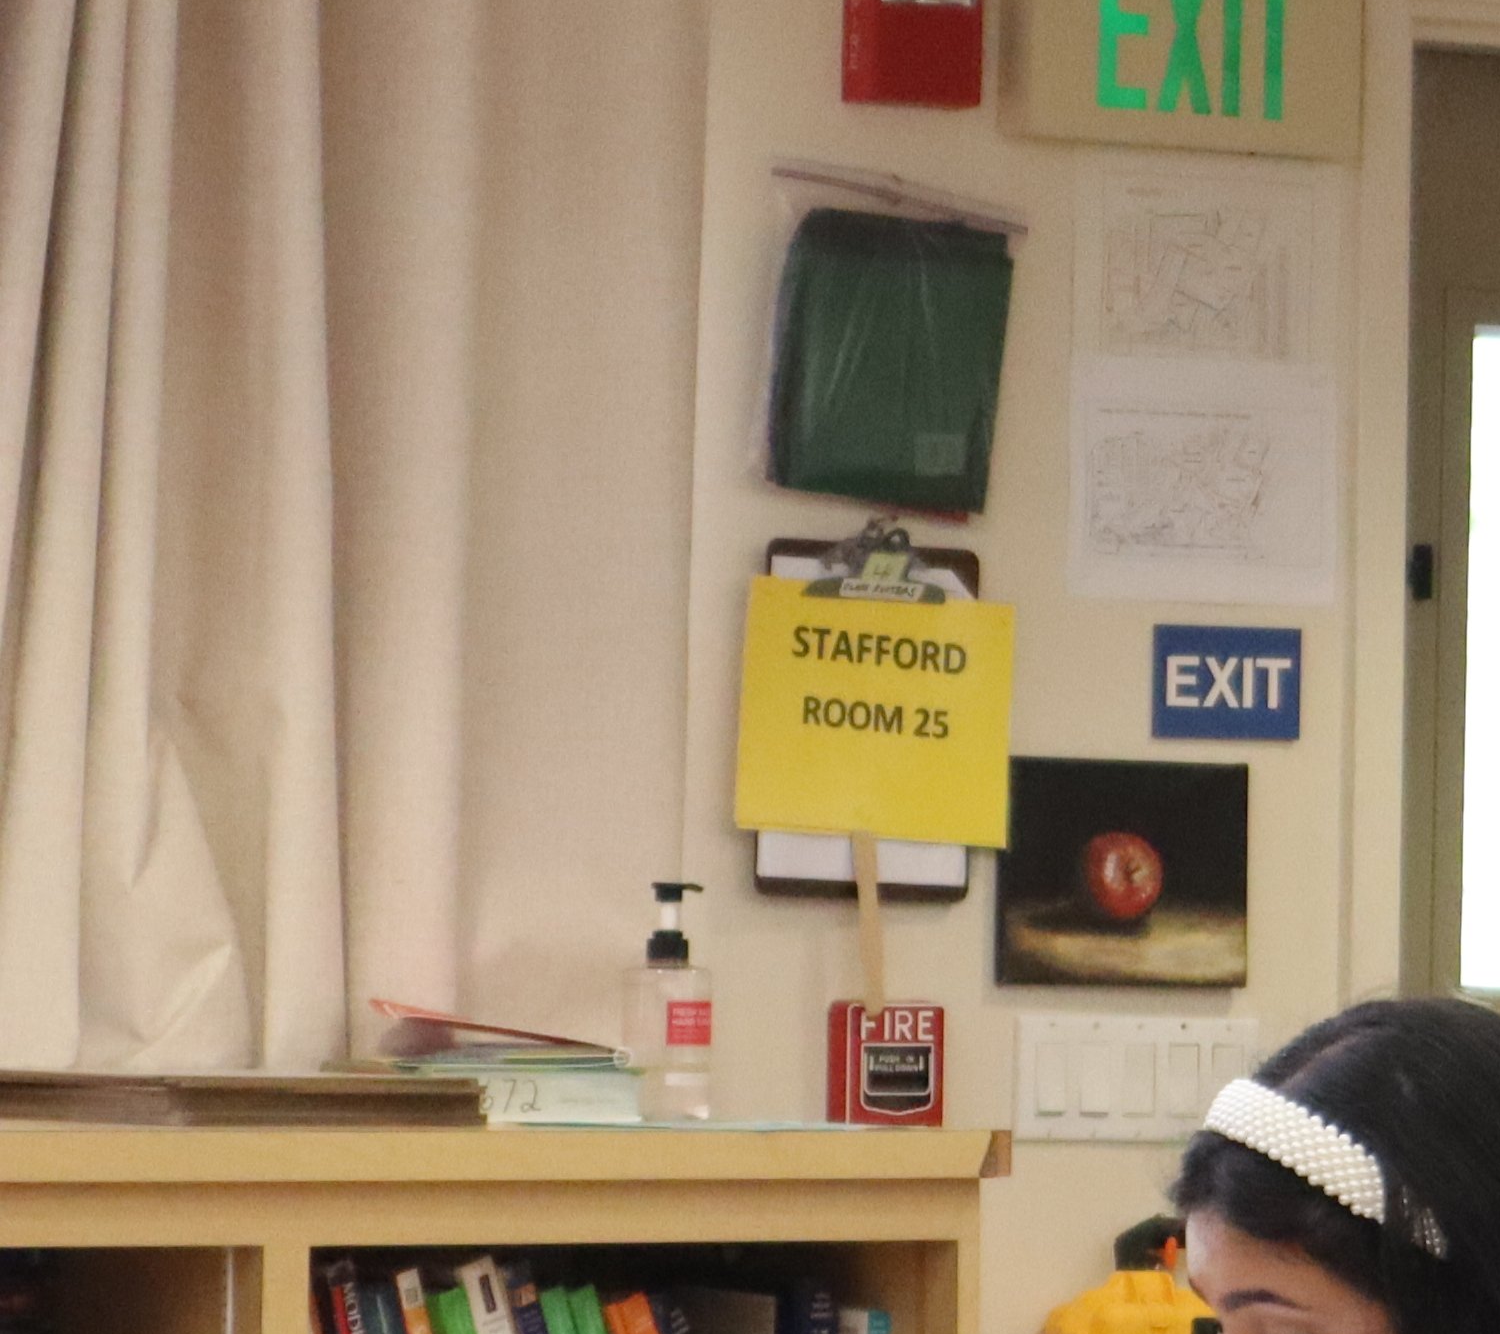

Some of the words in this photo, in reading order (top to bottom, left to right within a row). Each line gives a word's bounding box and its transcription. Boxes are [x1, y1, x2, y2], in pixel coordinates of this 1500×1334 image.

[791, 625, 967, 675] STAFFORD
[1165, 655, 1291, 710] EXIT
[803, 695, 904, 735] ROOM
[913, 708, 949, 739] 25
[860, 1010, 934, 1041] FIRE
